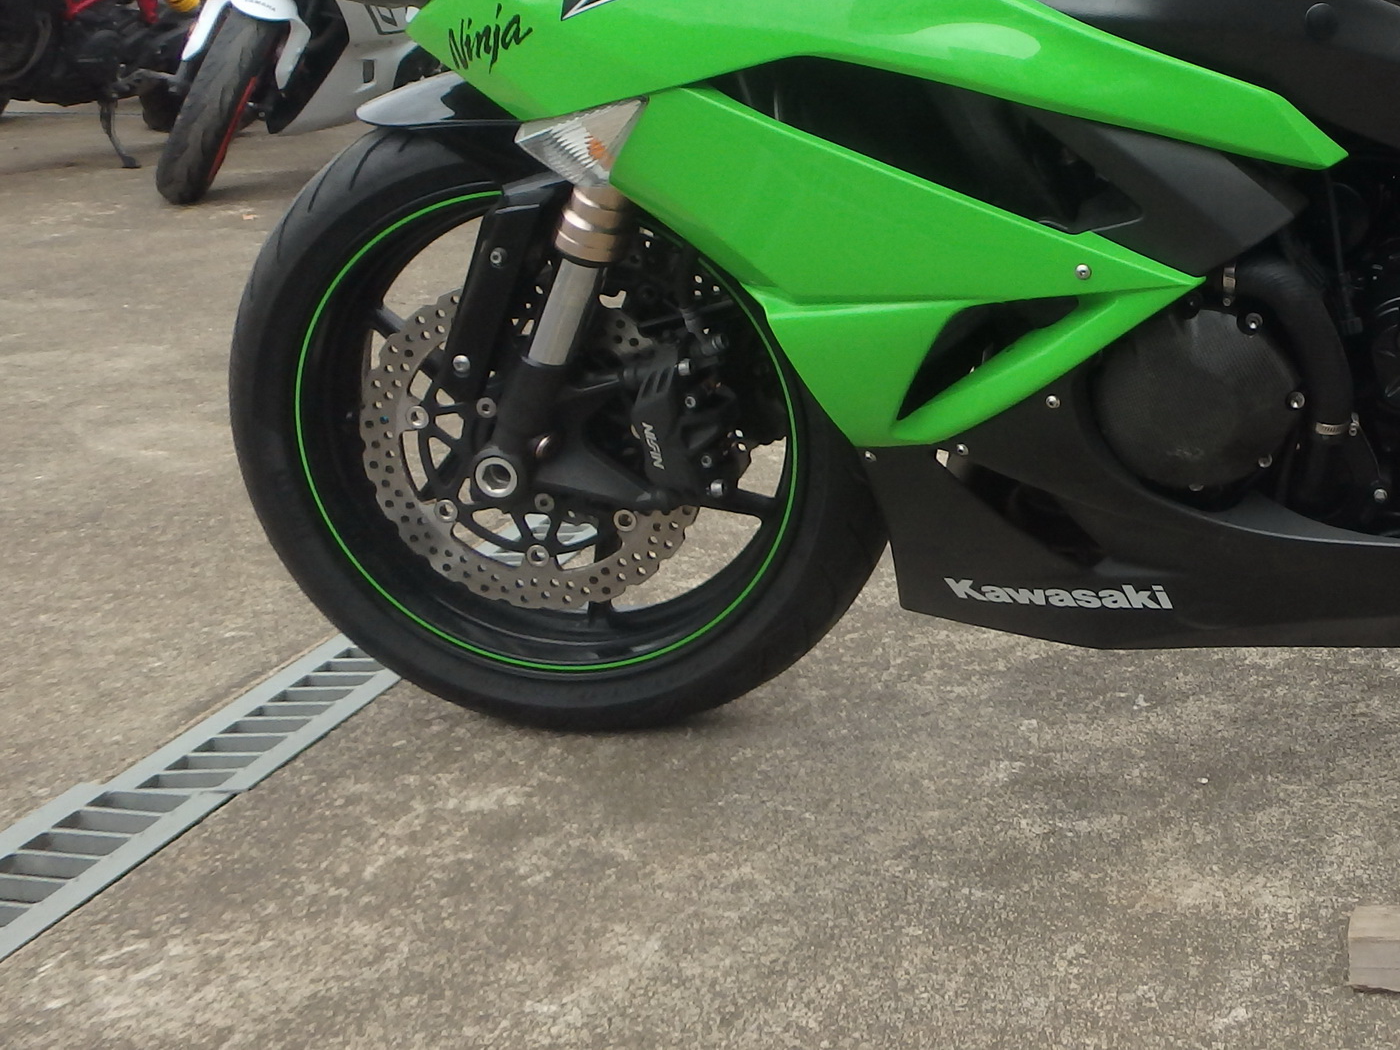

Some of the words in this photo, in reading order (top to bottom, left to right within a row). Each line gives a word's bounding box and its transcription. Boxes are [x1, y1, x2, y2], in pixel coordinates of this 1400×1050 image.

[449, 3, 533, 75] Ninja
[641, 422, 665, 470] NISSIN
[944, 577, 1174, 610] Kawasaki
